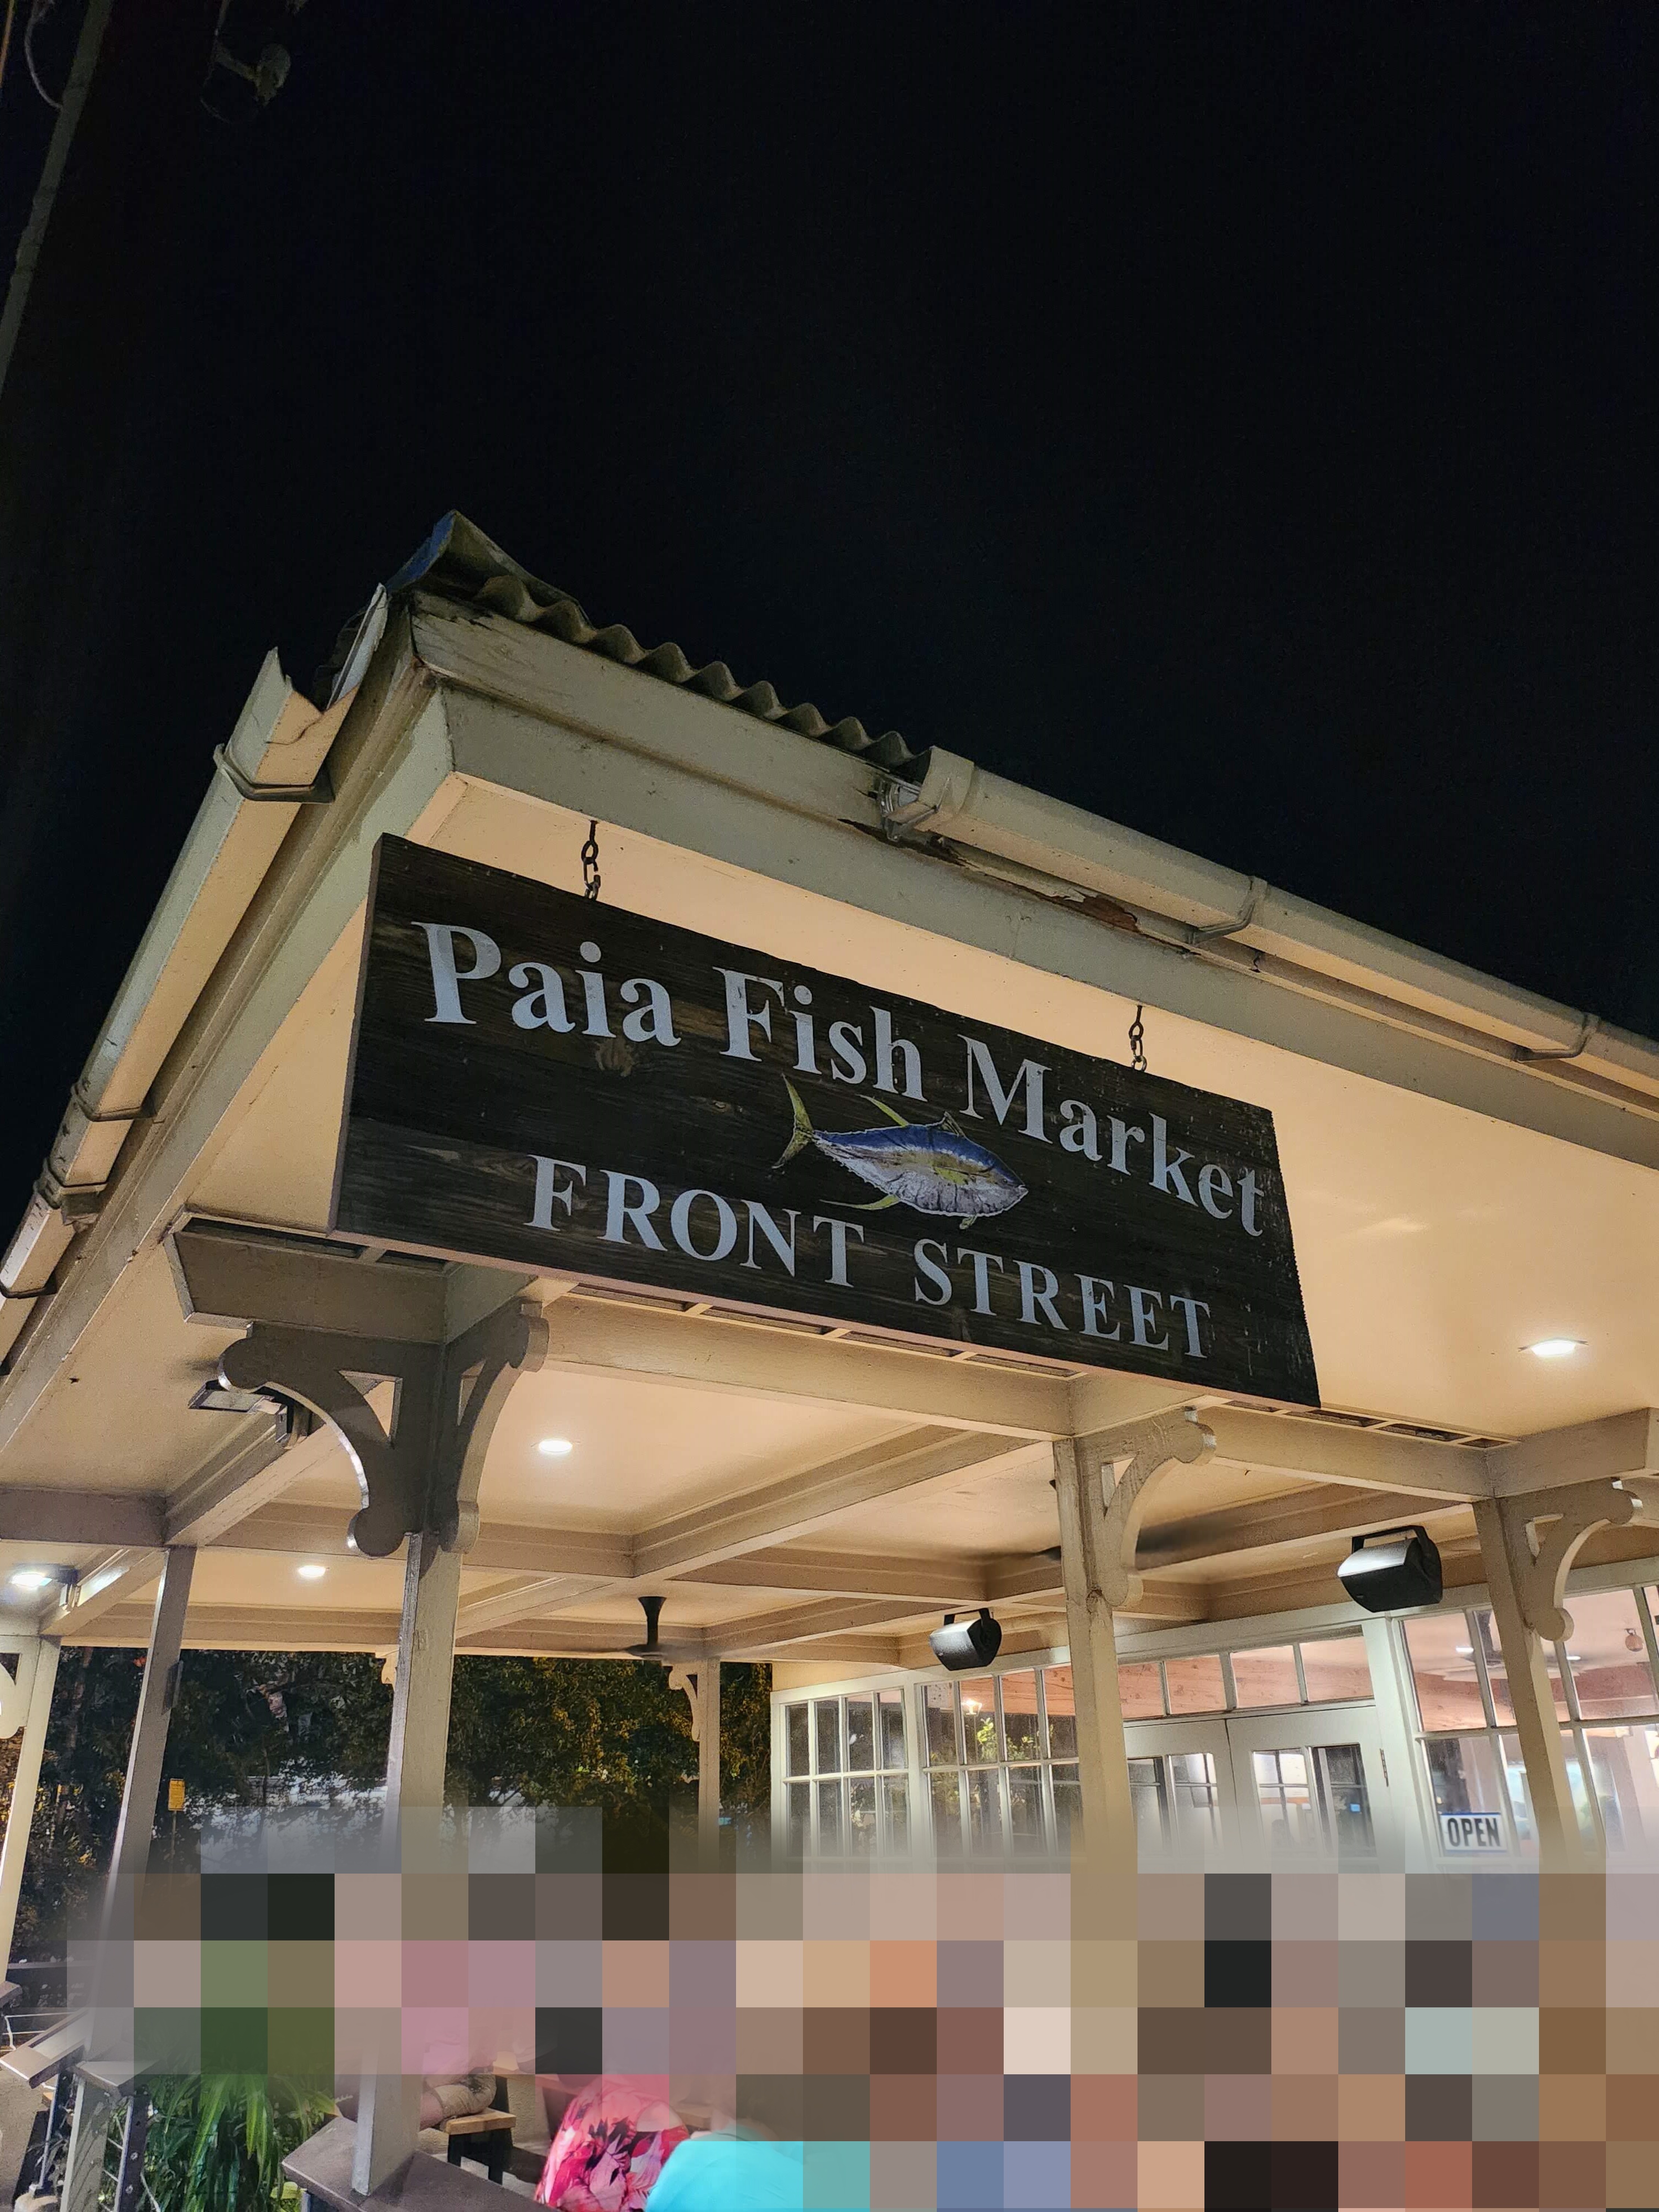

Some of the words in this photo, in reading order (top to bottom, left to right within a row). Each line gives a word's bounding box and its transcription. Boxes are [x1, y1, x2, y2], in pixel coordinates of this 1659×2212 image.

[411, 921, 681, 1047] Paia
[712, 967, 928, 1102] Fish
[957, 1034, 1265, 1237] Market
[523, 1154, 864, 1287] FRONT
[914, 1238, 1211, 1359] STREET
[1447, 1818, 1501, 1847] OPEN
